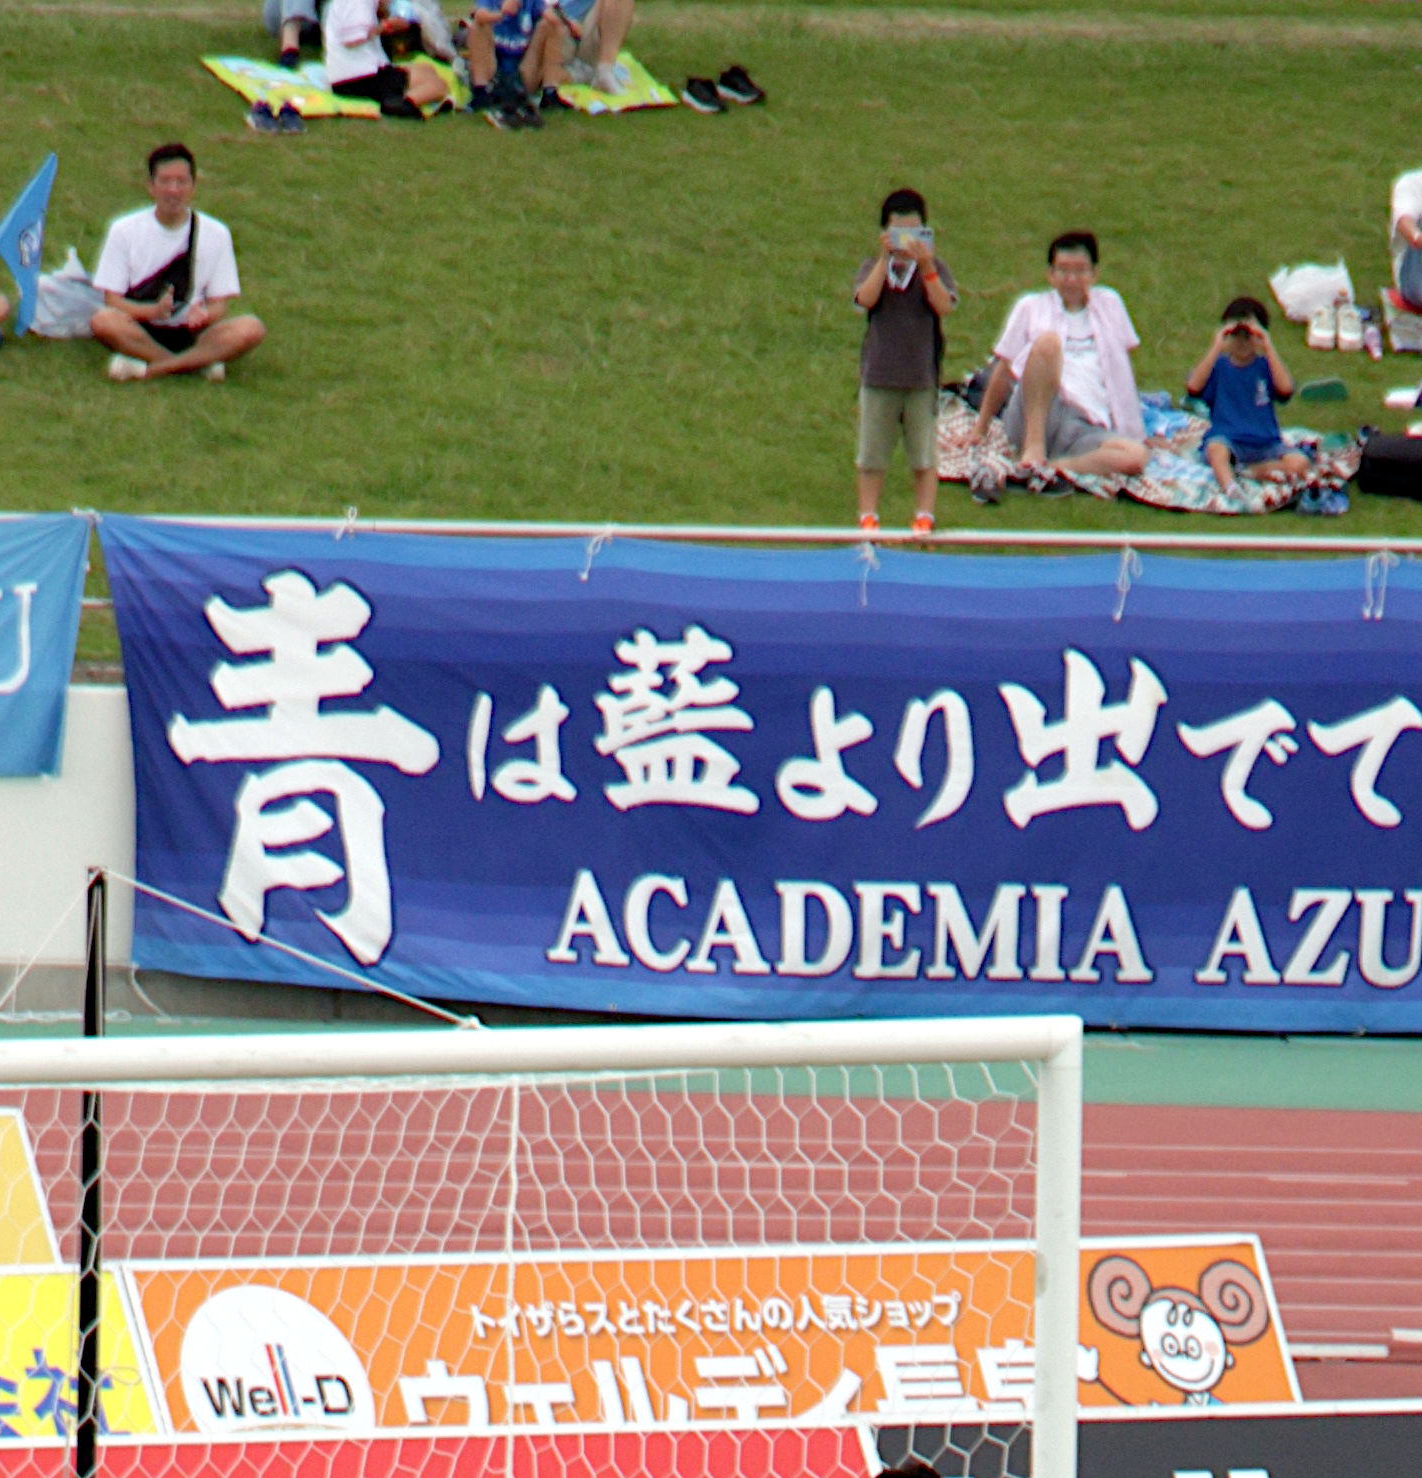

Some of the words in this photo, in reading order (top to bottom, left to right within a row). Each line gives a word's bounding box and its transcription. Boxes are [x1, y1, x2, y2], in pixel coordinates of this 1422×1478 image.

[547, 869, 1153, 985] ACADEMIA
[469, 1291, 962, 1339] トイザらスとたくさんの人気ショップ
[200, 1343, 356, 1418] Well-D
